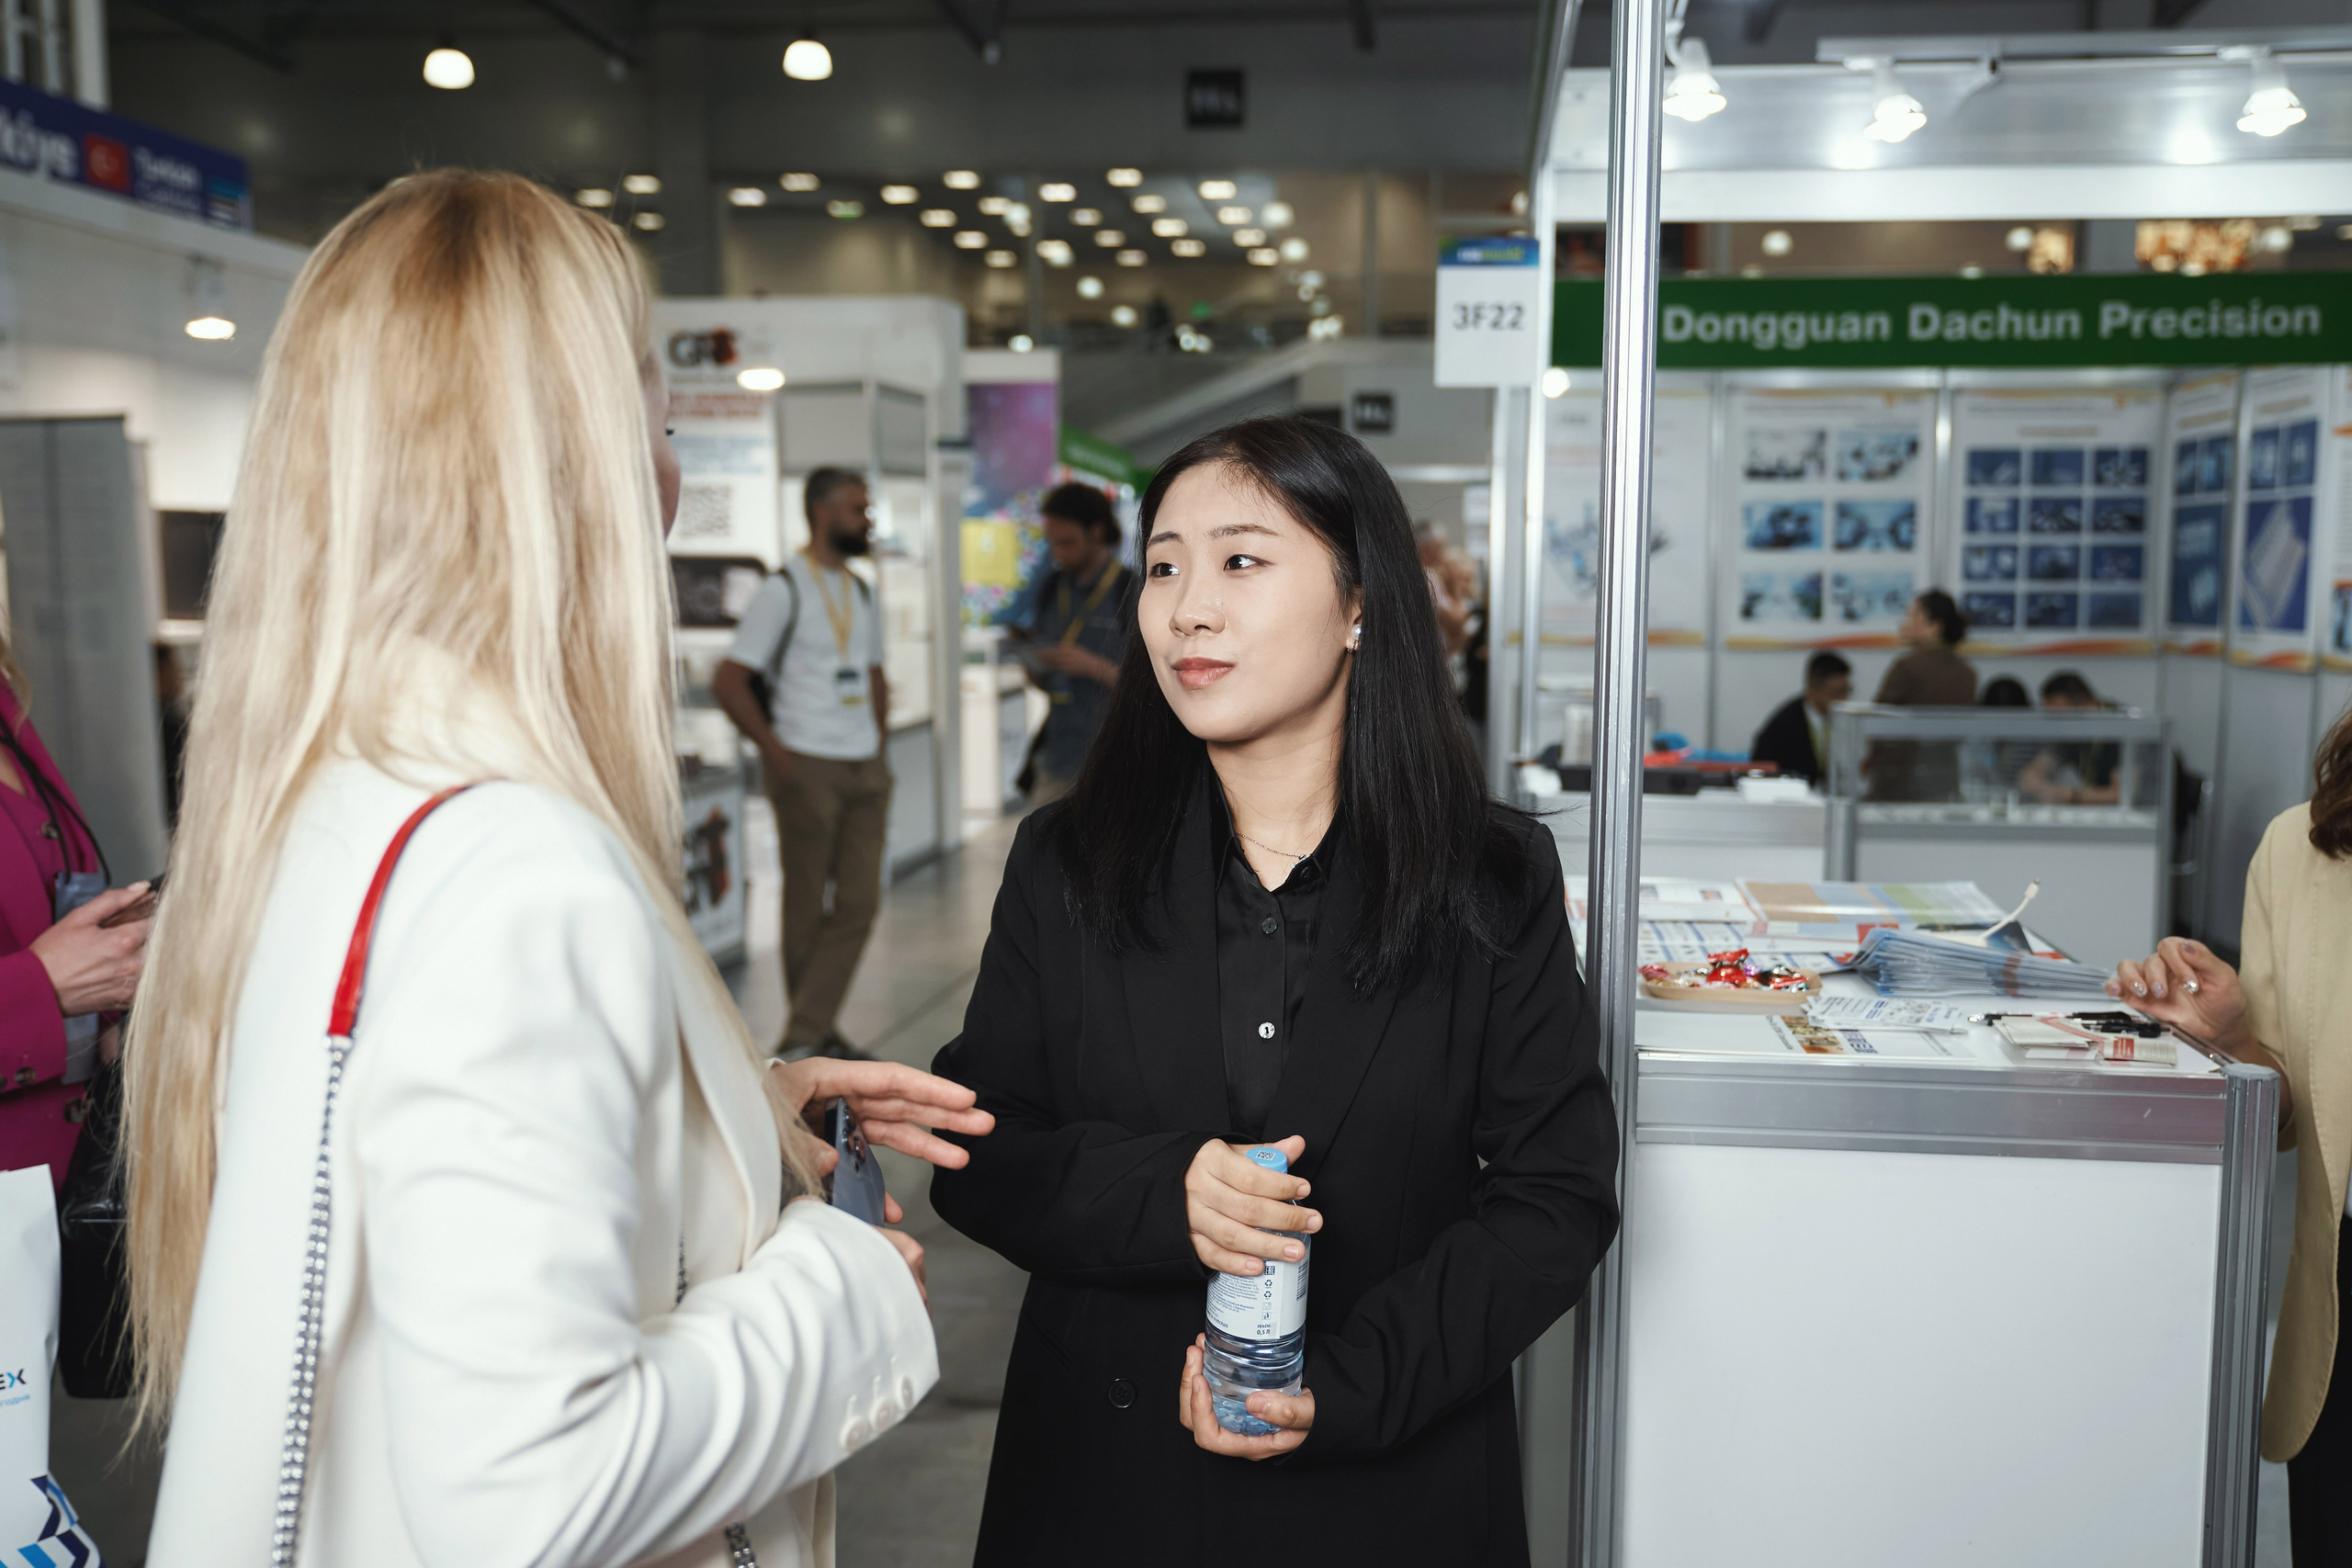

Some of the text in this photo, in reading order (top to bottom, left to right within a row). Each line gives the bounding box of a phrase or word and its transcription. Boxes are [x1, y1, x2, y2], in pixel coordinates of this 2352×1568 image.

[1453, 301, 1525, 331] 3F22
[1662, 298, 2322, 352] Dongguan Dachun Precision
